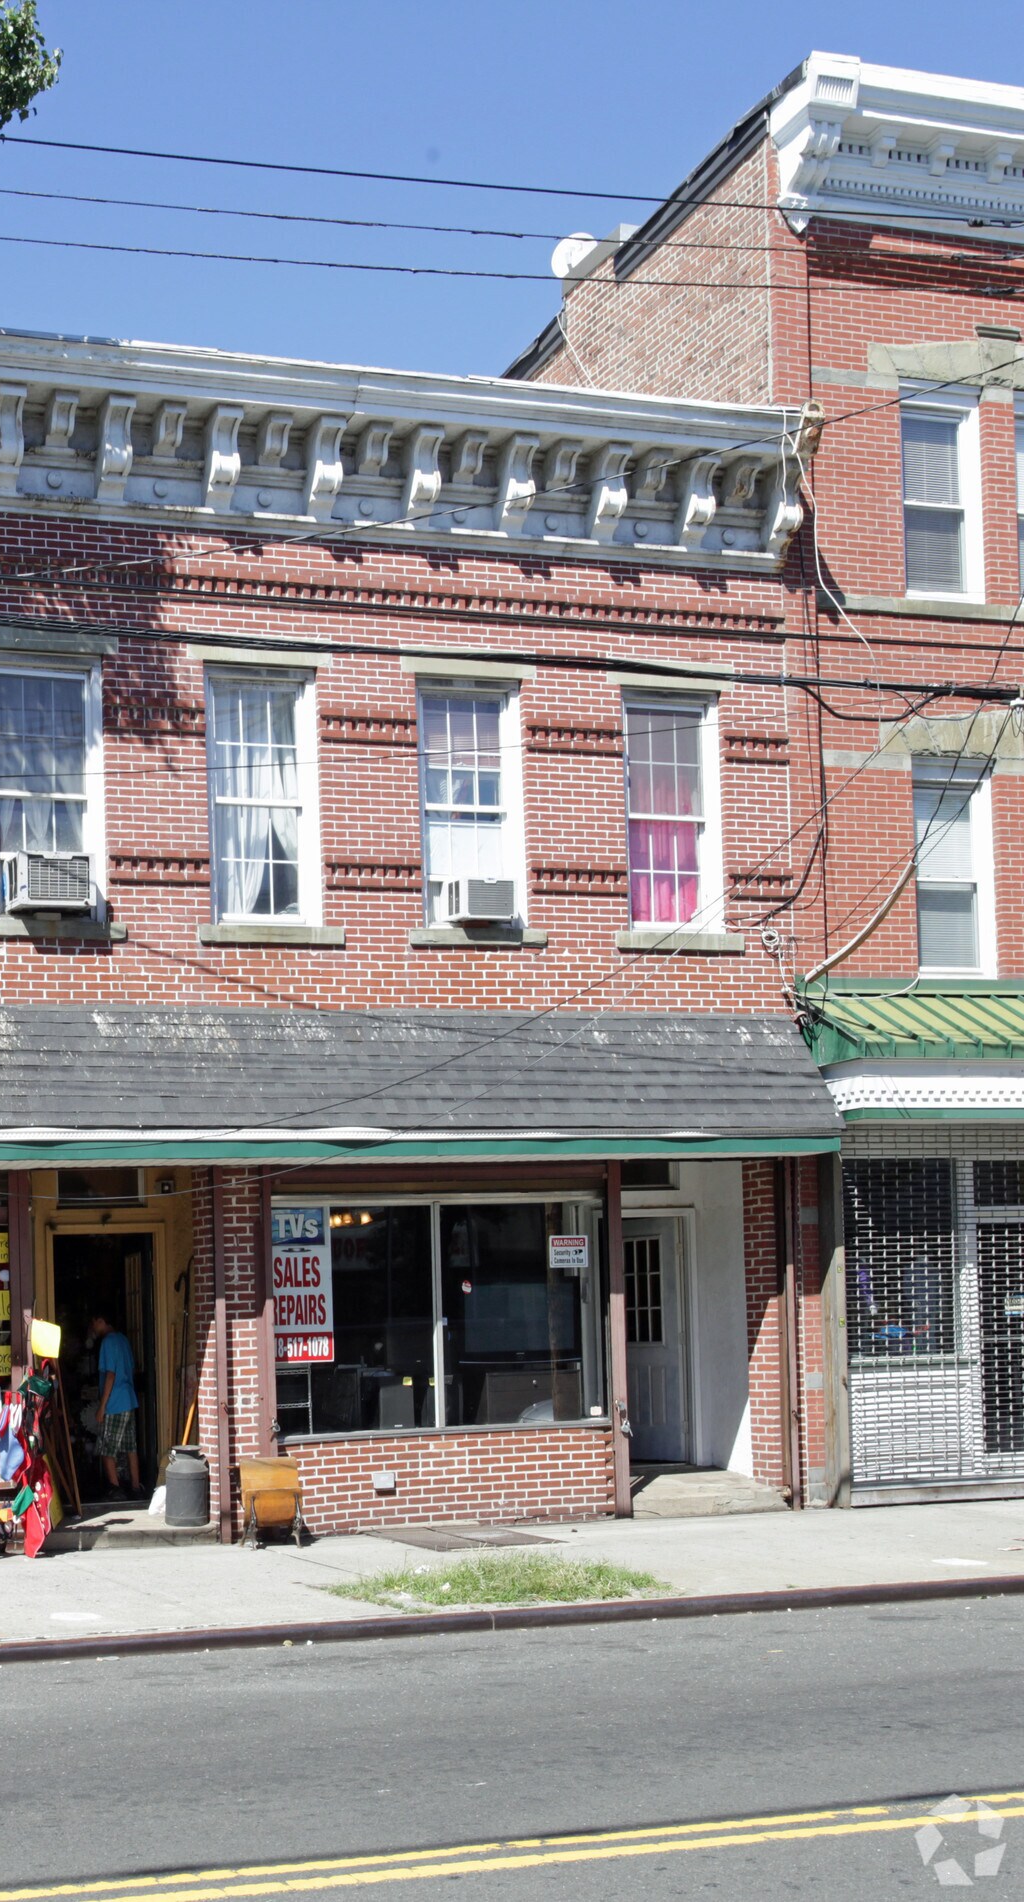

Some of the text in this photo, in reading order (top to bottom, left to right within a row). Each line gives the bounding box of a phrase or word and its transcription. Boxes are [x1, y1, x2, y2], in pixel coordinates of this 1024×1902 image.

[274, 1213, 319, 1239] TVs
[552, 1238, 584, 1246] WARNING
[273, 1256, 321, 1289] SALES
